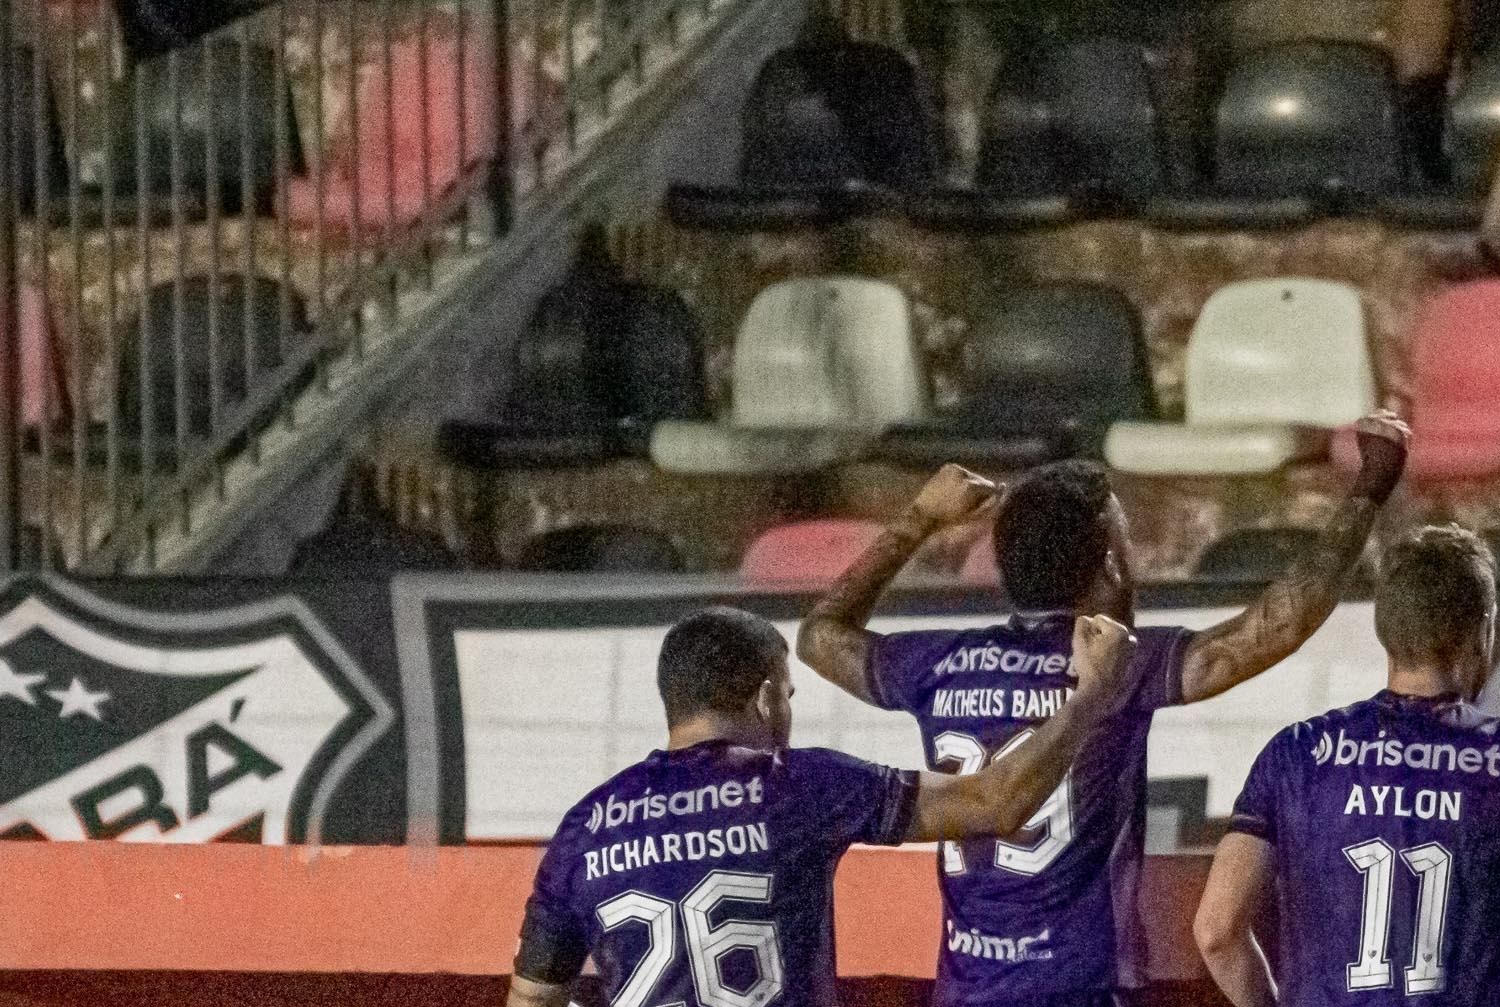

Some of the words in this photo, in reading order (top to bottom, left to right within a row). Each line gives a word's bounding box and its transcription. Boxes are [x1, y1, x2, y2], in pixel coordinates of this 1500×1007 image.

[932, 688, 1005, 718] MATHEUS
[604, 776, 763, 830] brisanet
[1343, 783, 1462, 821] AYLON
[584, 822, 769, 881] RICHARDSON
[1341, 836, 1453, 997] 11
